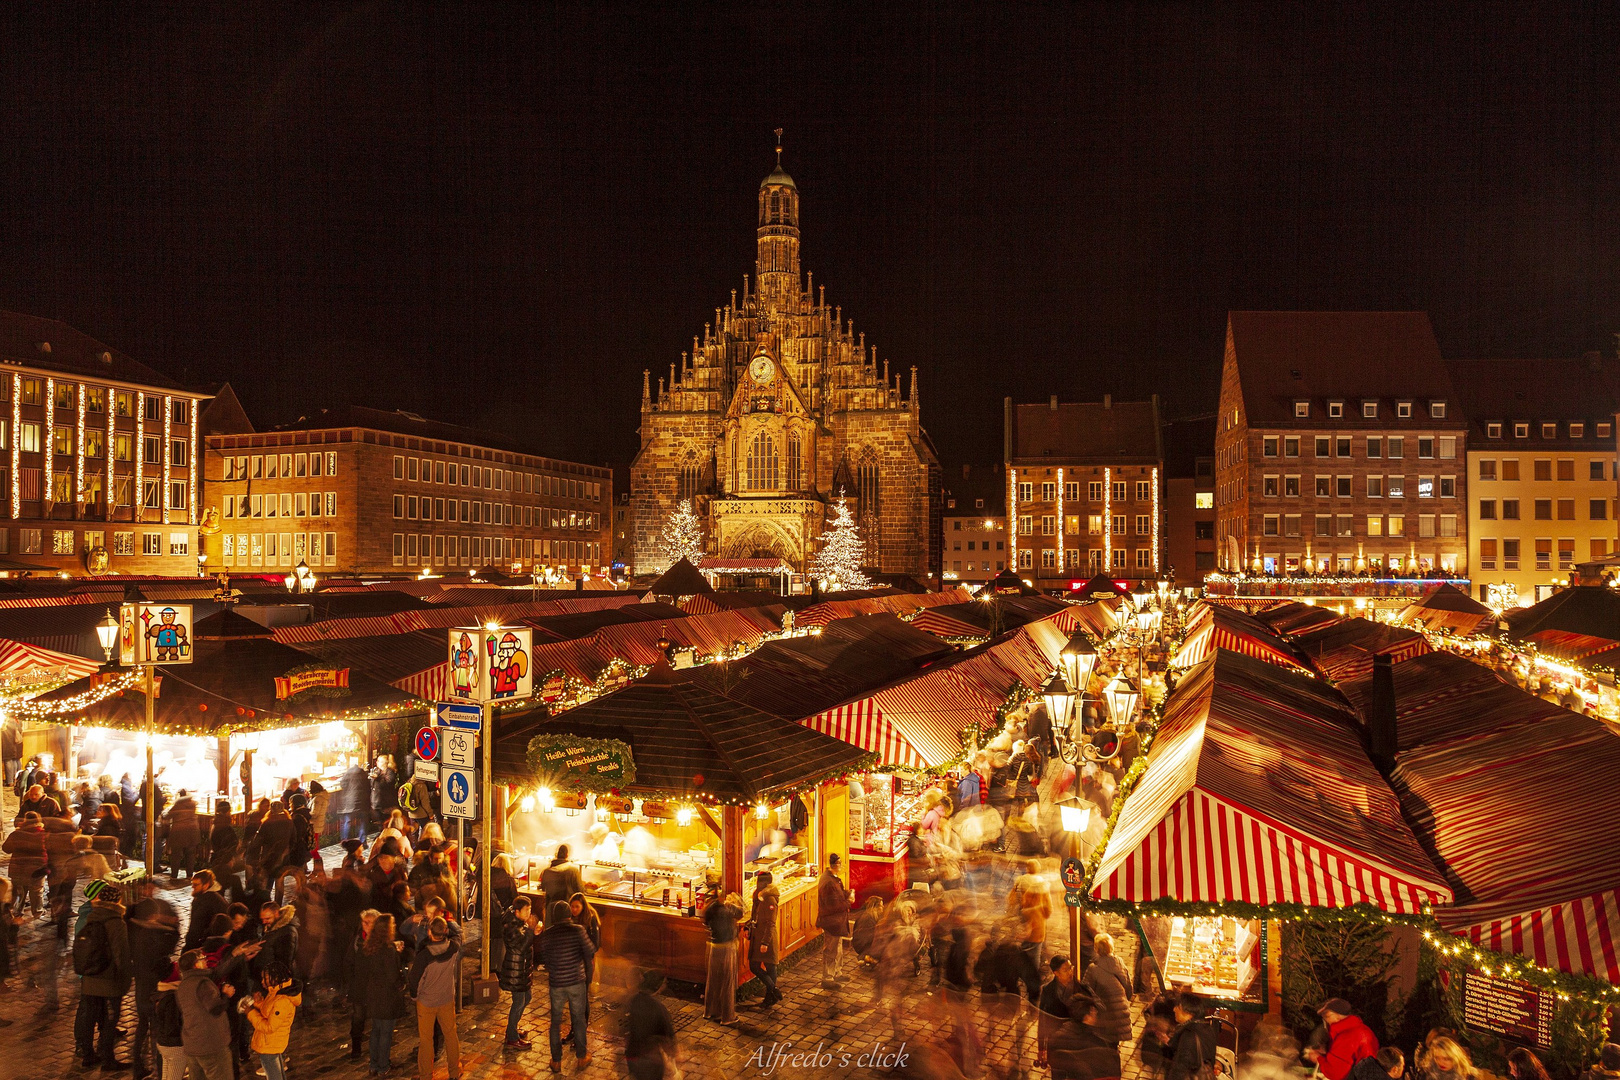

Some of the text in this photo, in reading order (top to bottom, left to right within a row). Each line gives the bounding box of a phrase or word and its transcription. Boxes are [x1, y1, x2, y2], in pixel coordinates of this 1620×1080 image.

[448, 712, 478, 722] Einbahnstraße
[545, 750, 566, 761] Heiße
[565, 752, 609, 768] Fleischküchle
[449, 805, 466, 815] ZONE
[1507, 983, 1524, 991] Punsch
